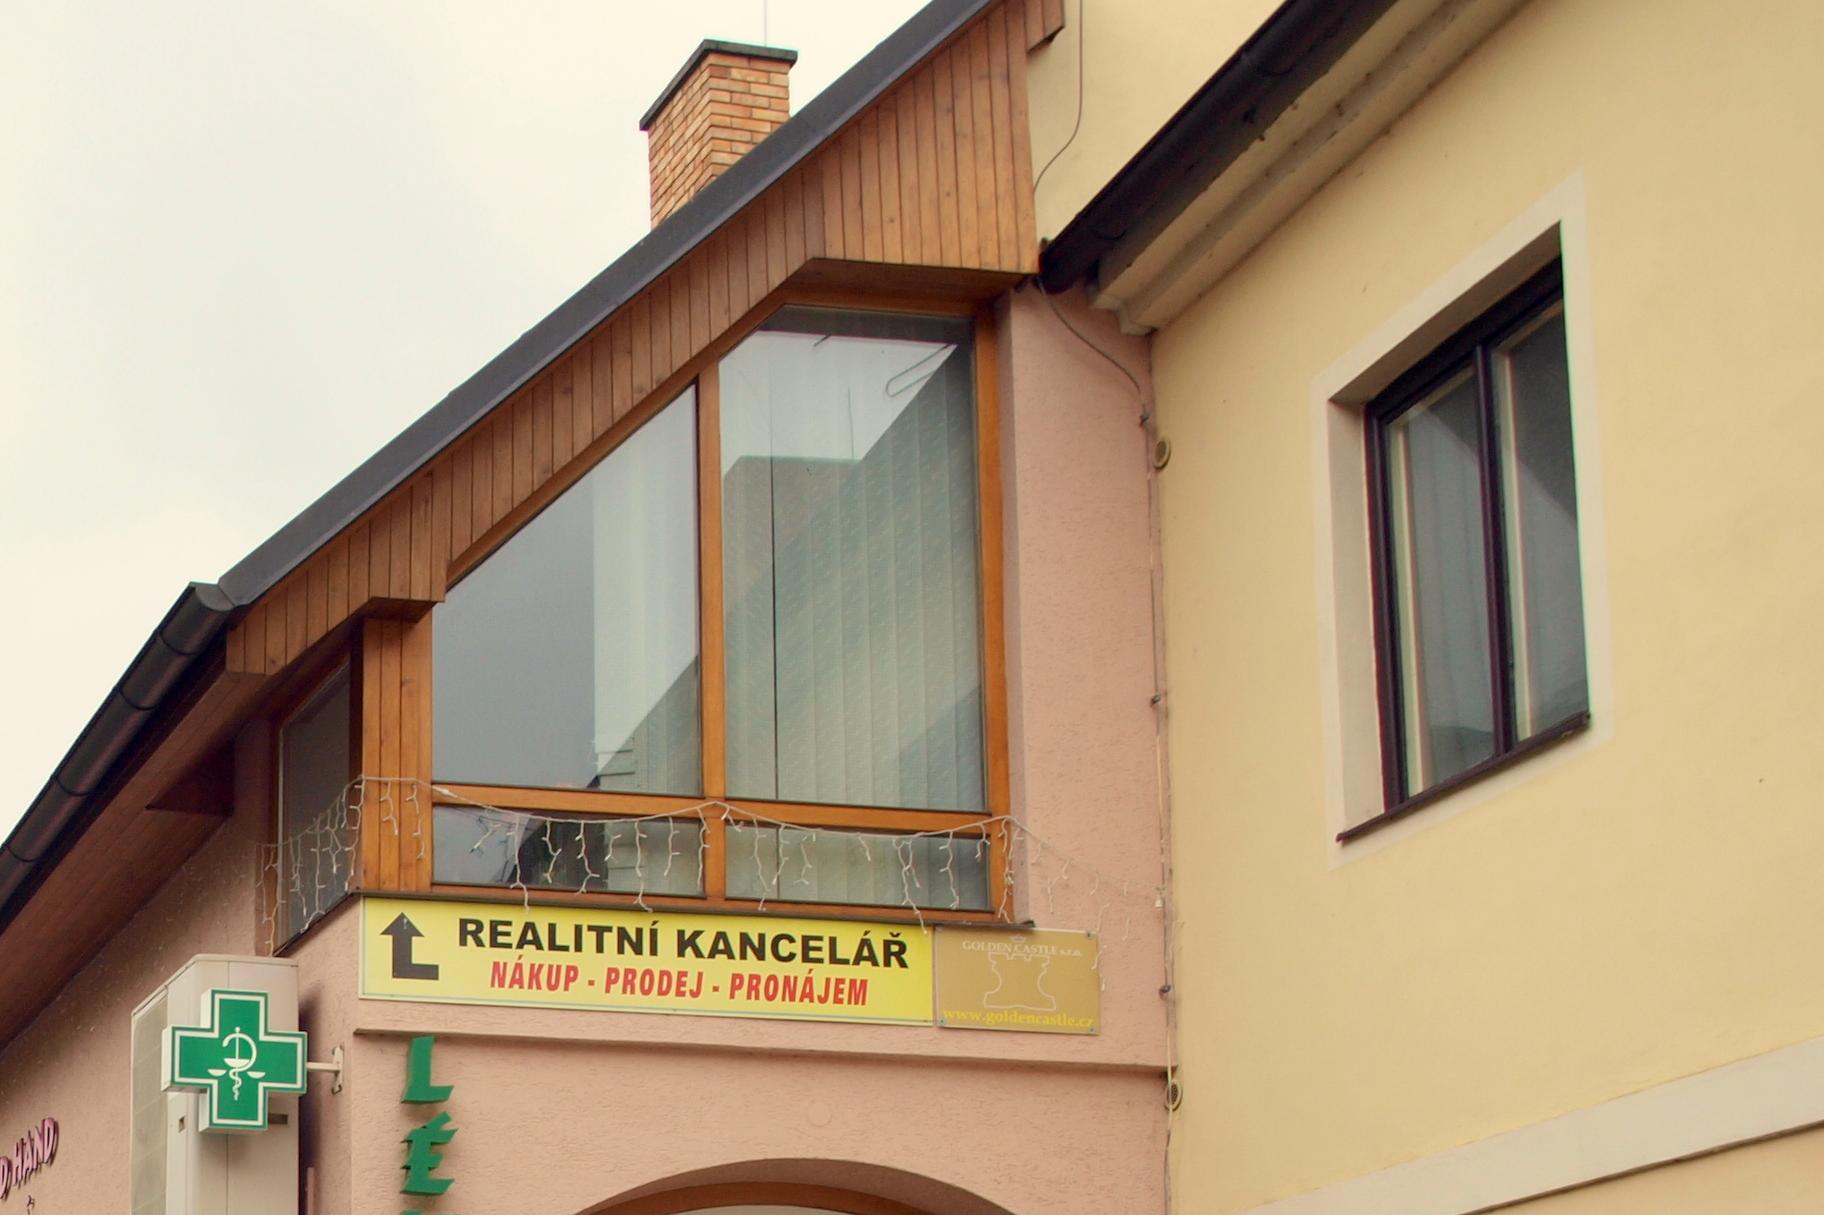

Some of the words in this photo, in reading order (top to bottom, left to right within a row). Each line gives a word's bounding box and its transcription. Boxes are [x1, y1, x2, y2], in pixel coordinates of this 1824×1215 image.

[459, 918, 659, 957] REALITNÍ
[676, 929, 909, 969] KANCELÁŘ
[962, 940, 1012, 953] GOLDEN
[1014, 944, 1057, 956] CASTLE
[490, 954, 579, 992] NÁKUP
[604, 967, 704, 999] PRODEJ
[729, 968, 868, 1006] PRONÁJEM
[943, 1009, 1094, 1028] www.goldencastle.cz
[12, 1117, 59, 1189] HAND
